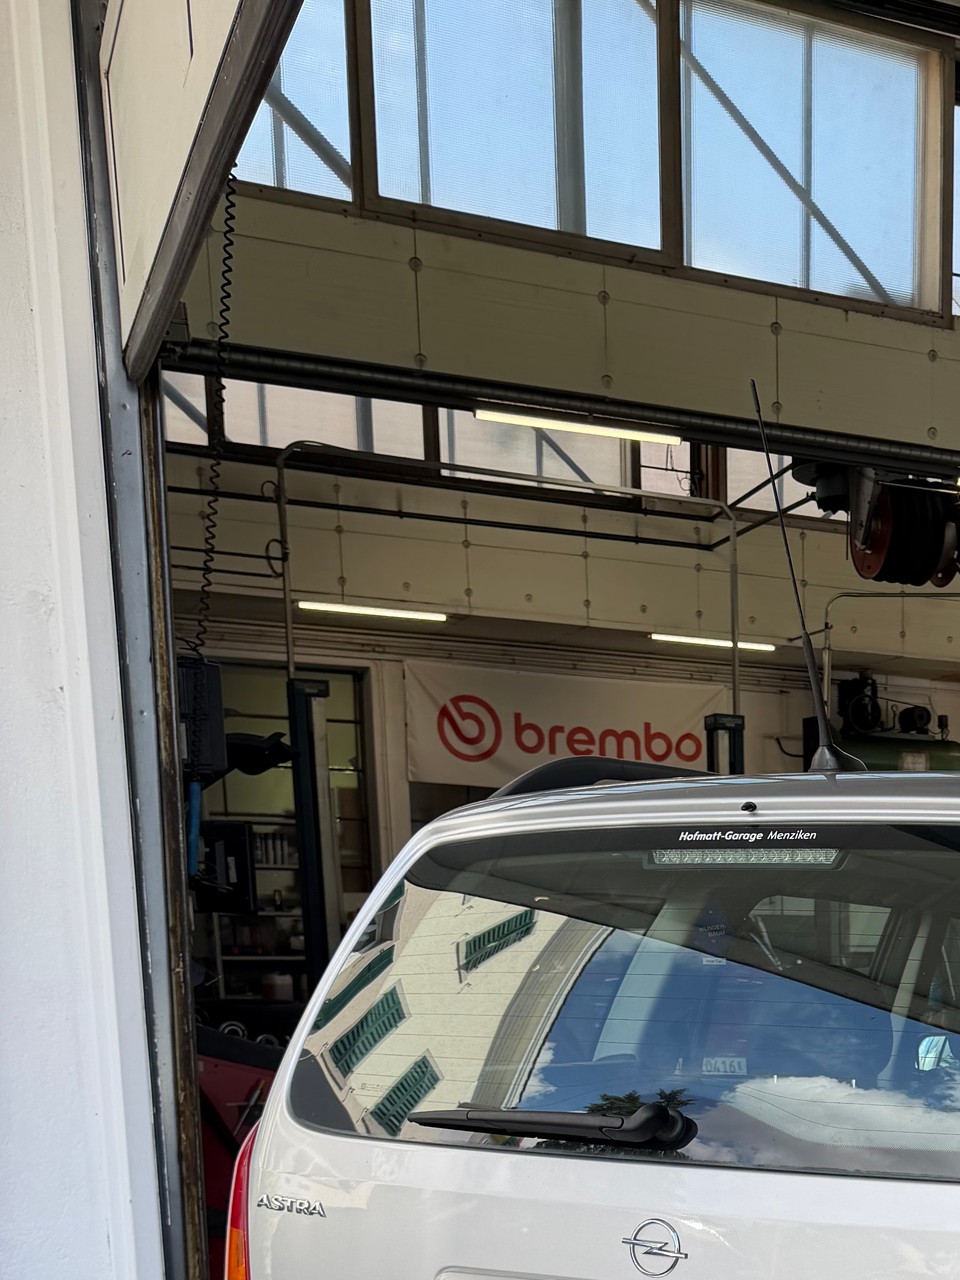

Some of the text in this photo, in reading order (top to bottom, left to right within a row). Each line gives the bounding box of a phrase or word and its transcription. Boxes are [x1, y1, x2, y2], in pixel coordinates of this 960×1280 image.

[514, 712, 703, 762] brembo
[679, 829, 817, 843] Hofmatt-Garage Menziken
[257, 1194, 326, 1218] ASTRA
